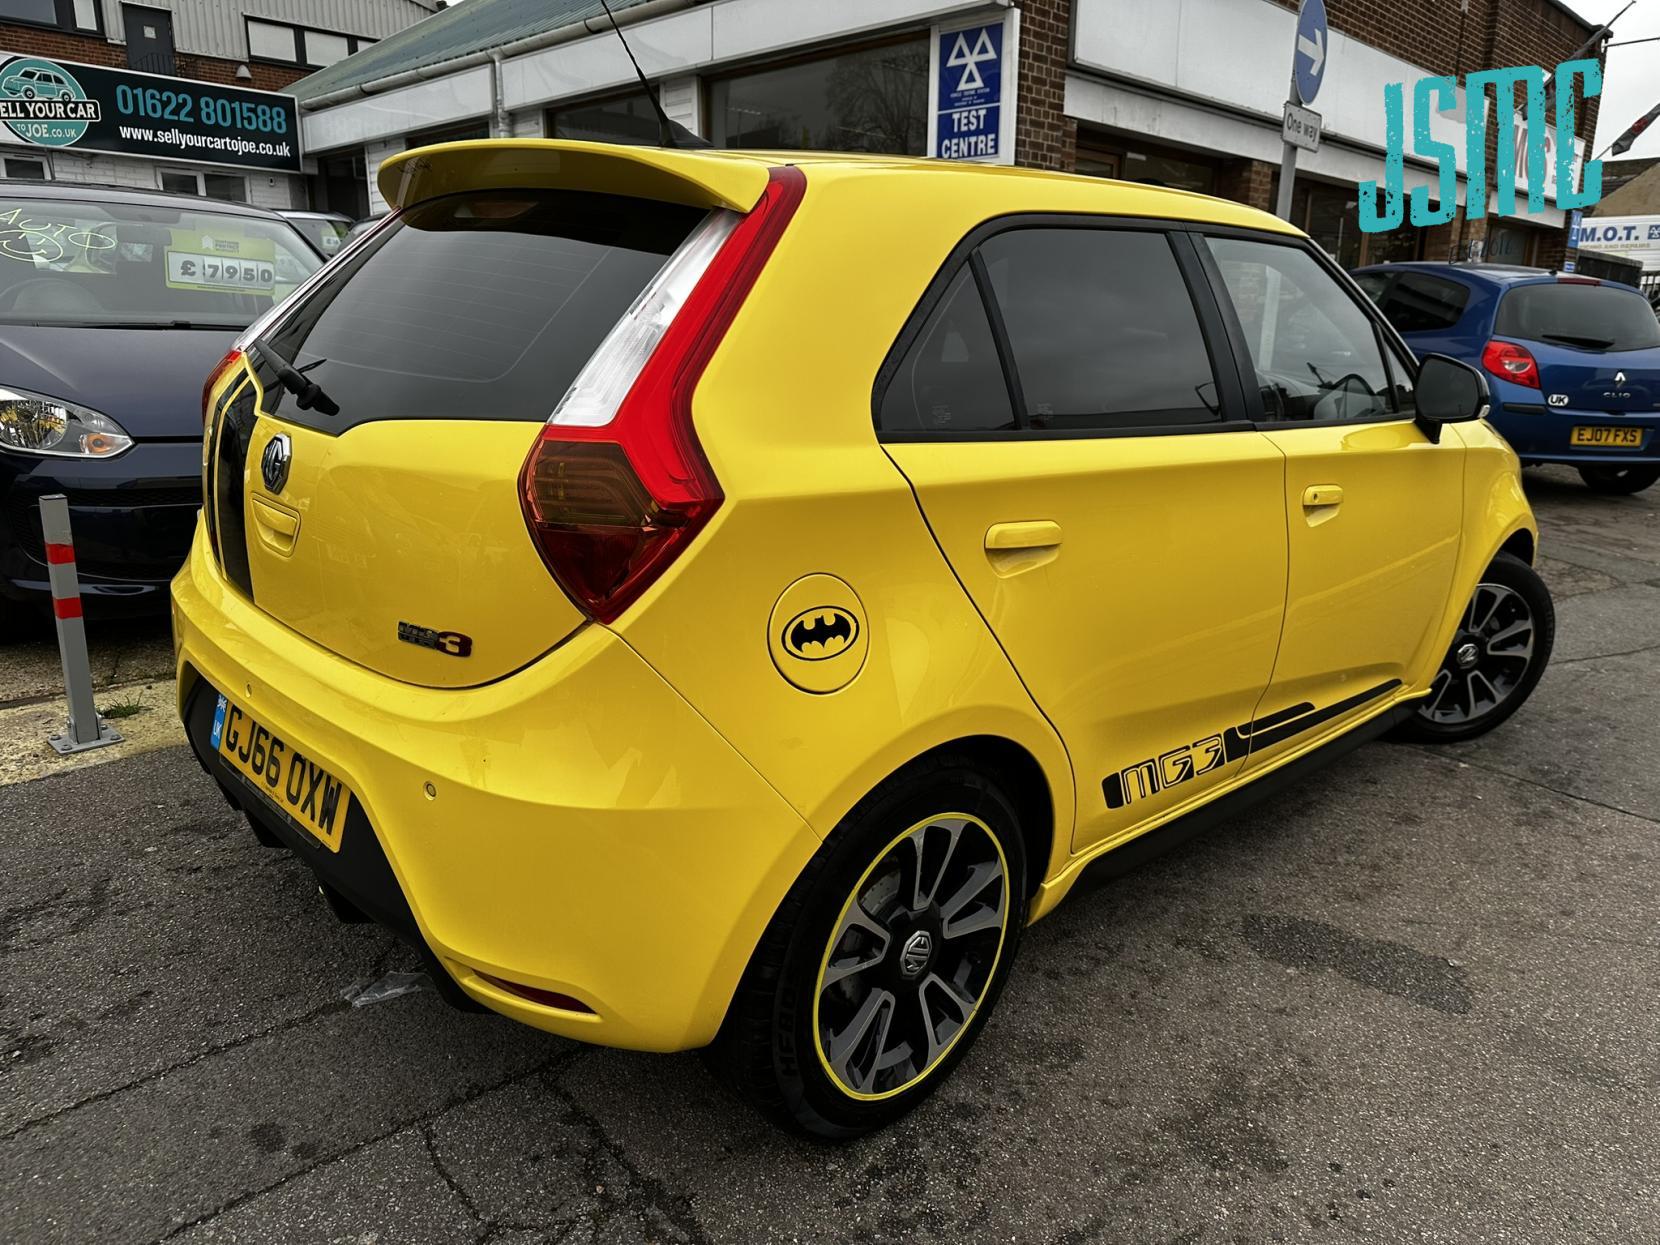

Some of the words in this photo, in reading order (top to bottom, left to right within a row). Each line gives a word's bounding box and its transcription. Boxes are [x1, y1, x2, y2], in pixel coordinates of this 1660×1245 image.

[25, 102, 65, 118] YOUR
[67, 103, 96, 118] CAR
[115, 84, 194, 122] 01622
[200, 96, 287, 134] 801588
[952, 108, 987, 133] TEST
[26, 124, 77, 137] JOE.CO.UK
[1287, 112, 1302, 134] One
[1303, 123, 1318, 142] way
[119, 126, 291, 157] www.sellyourcartojoe.co.uk
[941, 133, 996, 159] CENTRE
[1580, 226, 1639, 242] M.O.T.
[1549, 396, 1566, 405] UK
[1577, 428, 1612, 443] EJ07
[1613, 428, 1638, 443] FXS
[225, 703, 285, 788] GJ66
[285, 751, 343, 837] OXW
[1120, 732, 1226, 805] MG3
